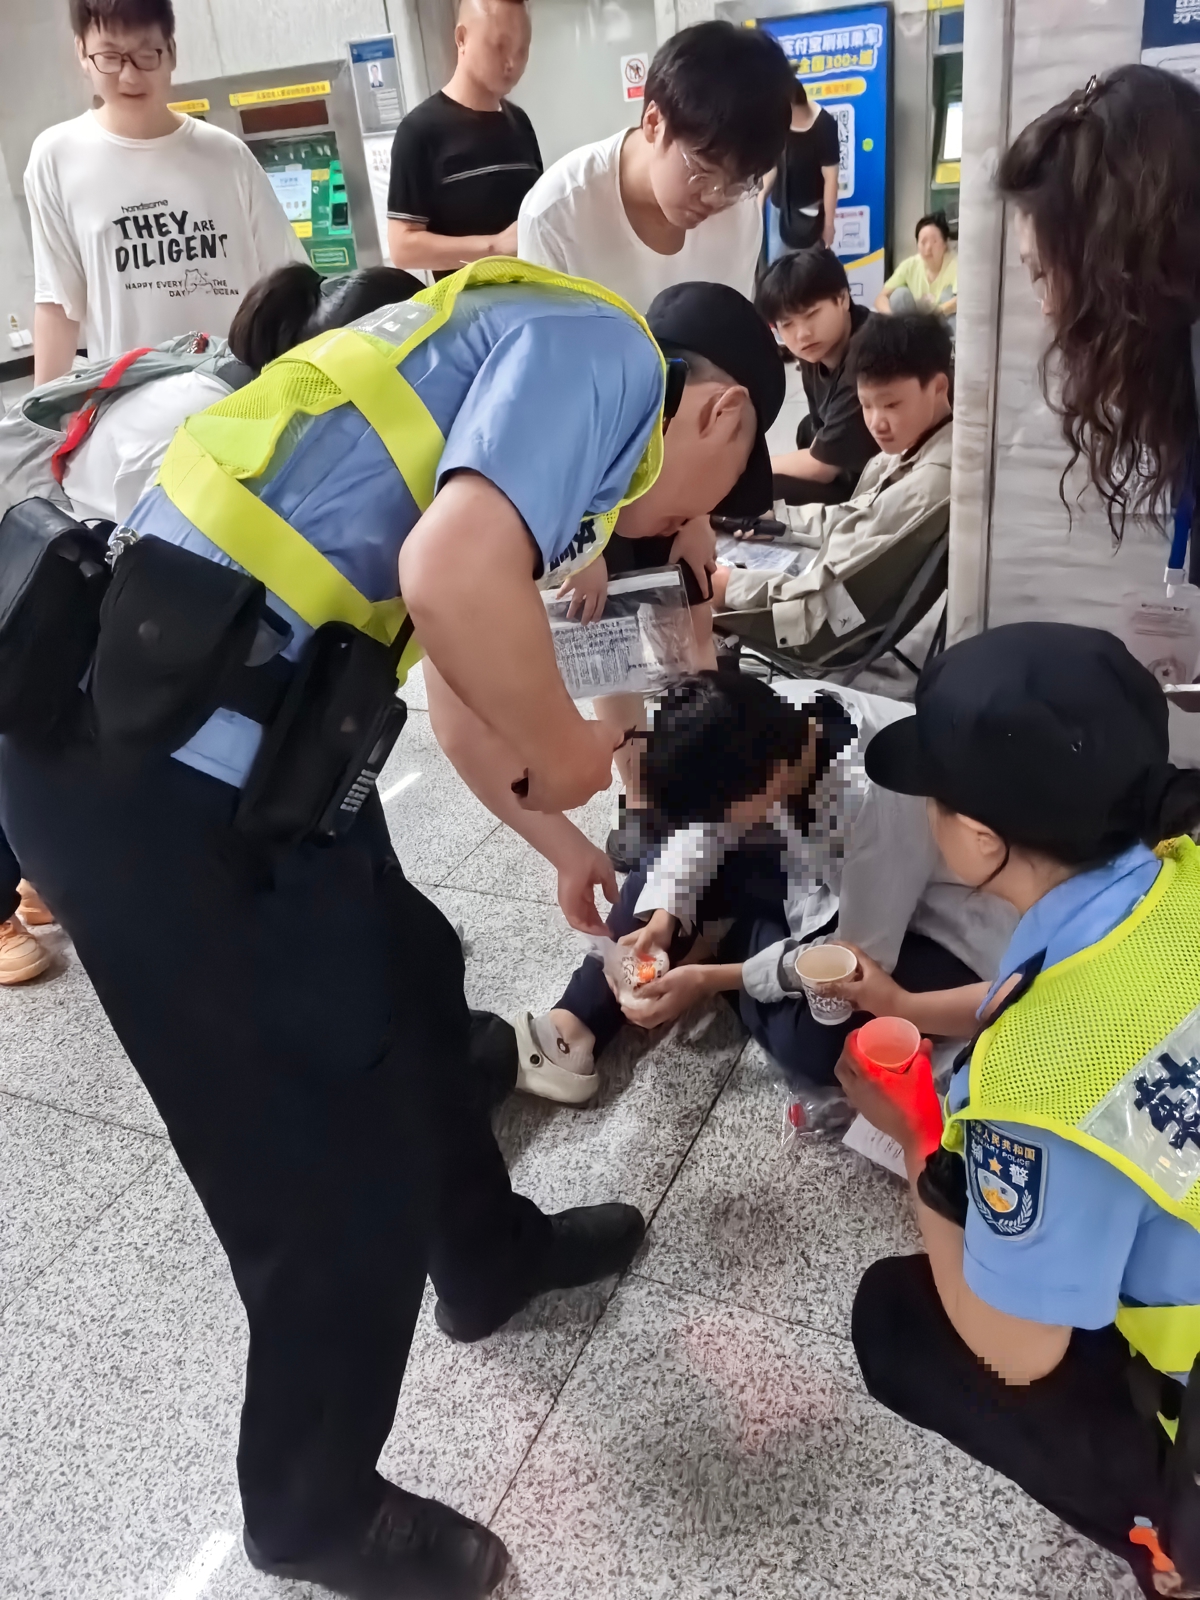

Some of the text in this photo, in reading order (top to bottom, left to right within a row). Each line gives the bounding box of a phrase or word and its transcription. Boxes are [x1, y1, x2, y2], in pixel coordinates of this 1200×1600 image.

[121, 199, 168, 213] handsome
[112, 210, 215, 240] THEY ARE
[115, 233, 227, 273] DILIGENT
[125, 279, 227, 290] HAPPY EVERY THE
[1002, 1152, 1031, 1169] POLICE
[1009, 1163, 1029, 1188] 警
